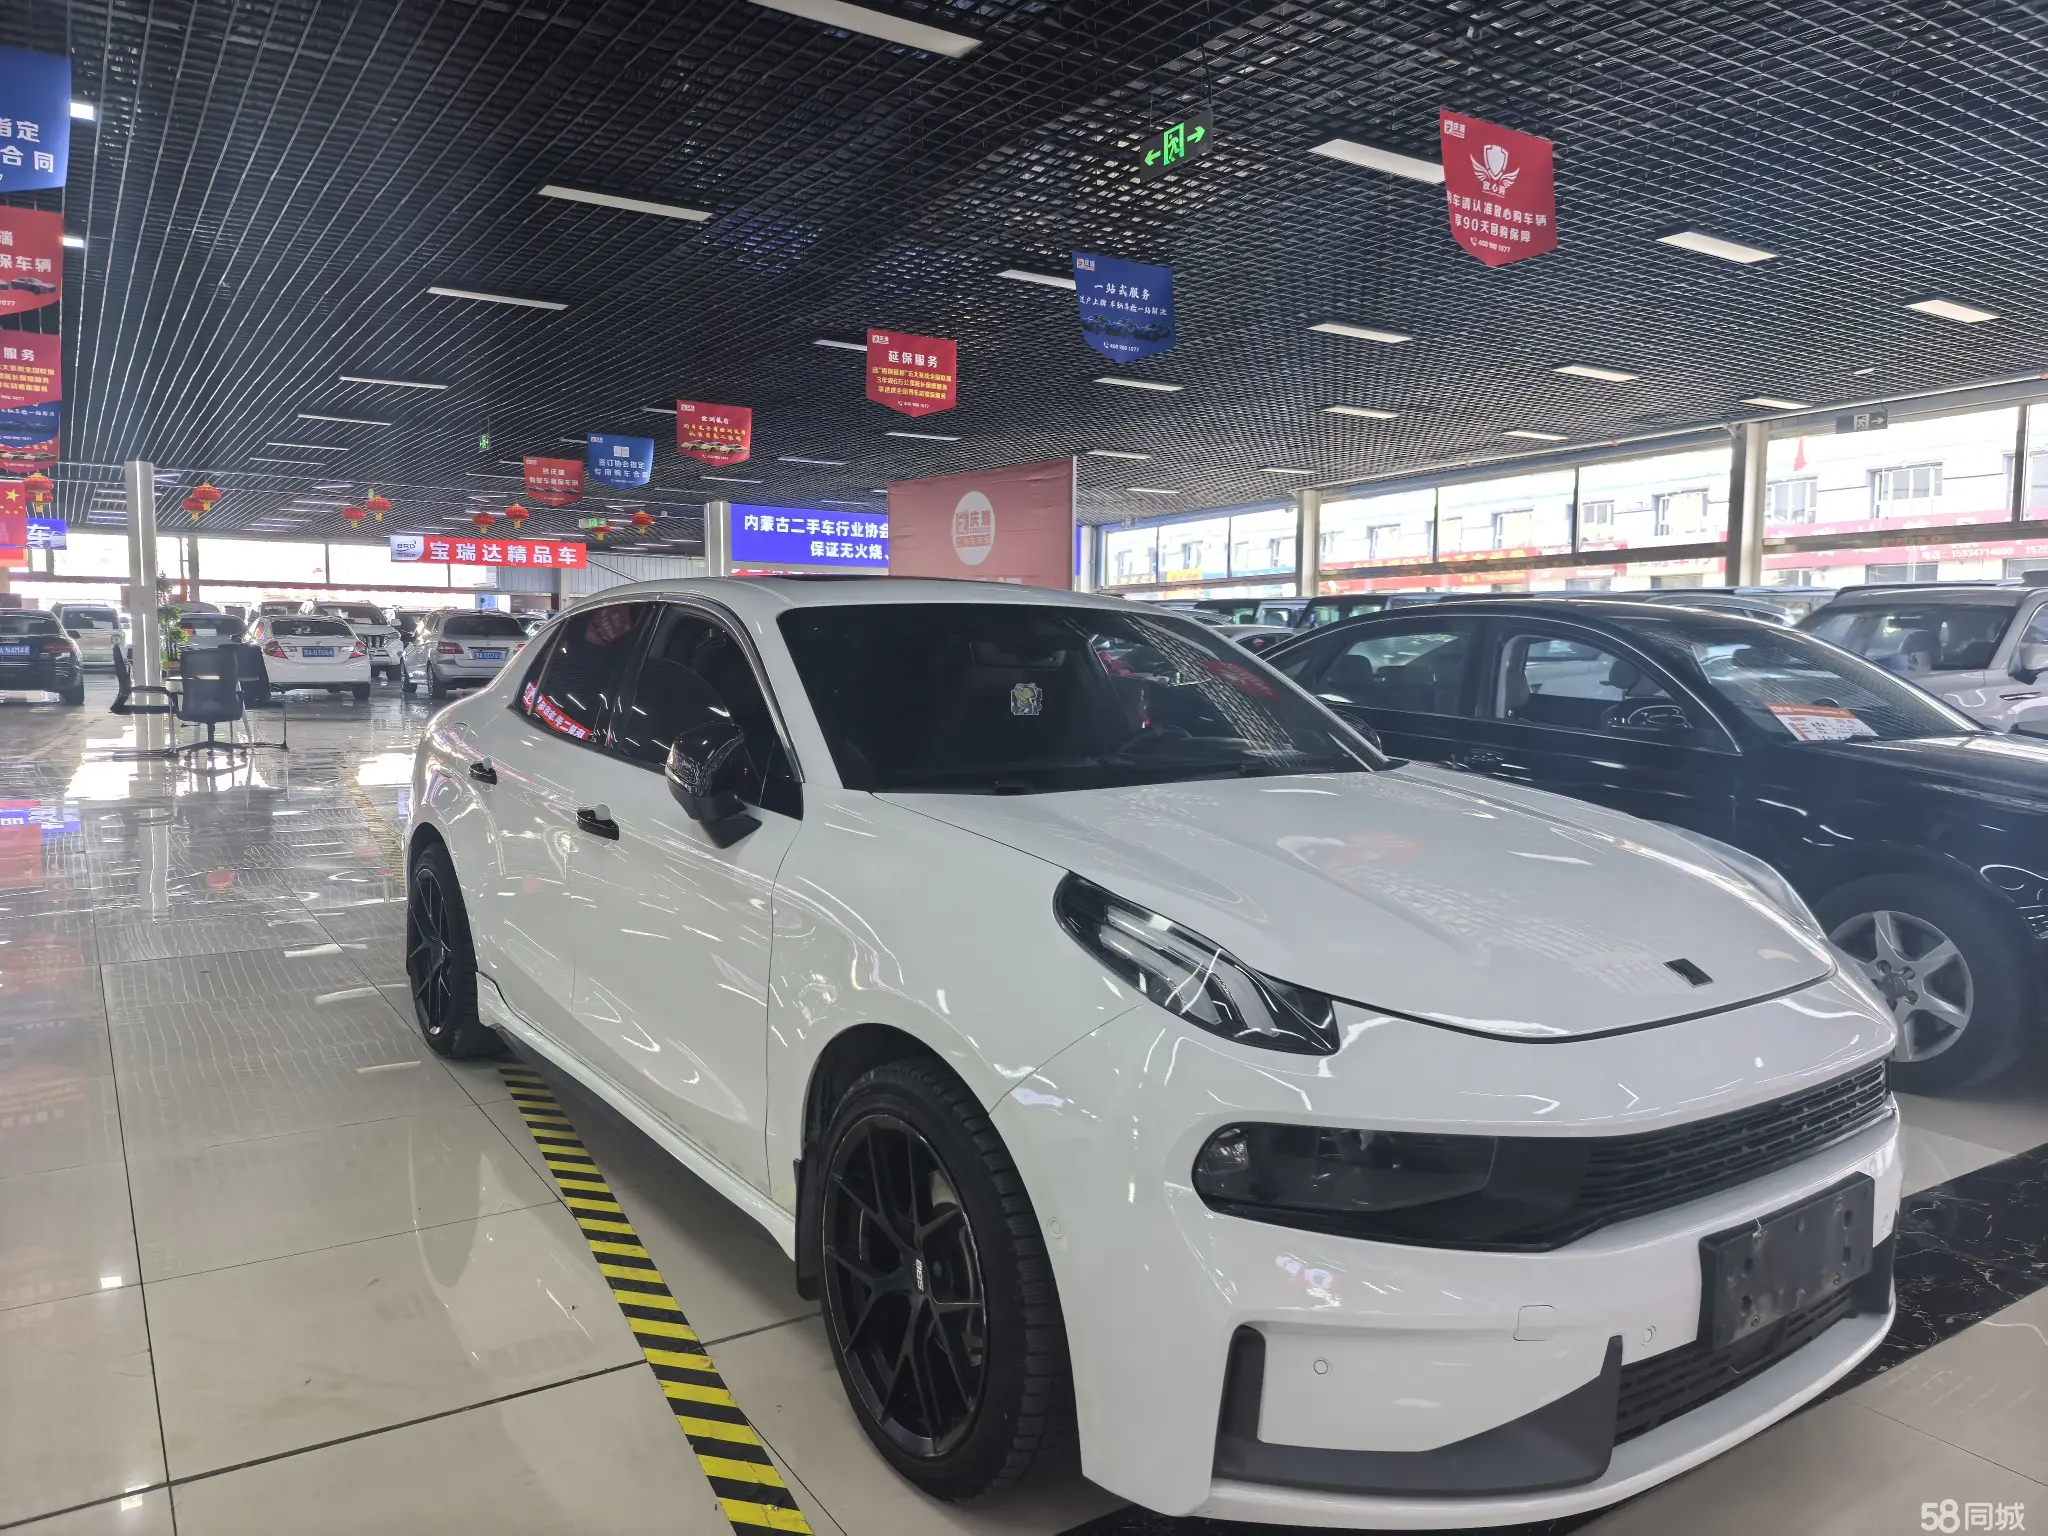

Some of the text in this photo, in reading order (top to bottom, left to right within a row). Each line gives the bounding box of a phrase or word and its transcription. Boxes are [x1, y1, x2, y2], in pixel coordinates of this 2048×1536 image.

[0, 145, 54, 173] 合同
[1094, 282, 1151, 301] 一站式服务
[3, 346, 35, 362] 服务
[888, 350, 938, 368] 延保服务
[744, 514, 889, 539] 内蒙古二手车行业协会
[429, 541, 578, 565] 宝瑞达精品车
